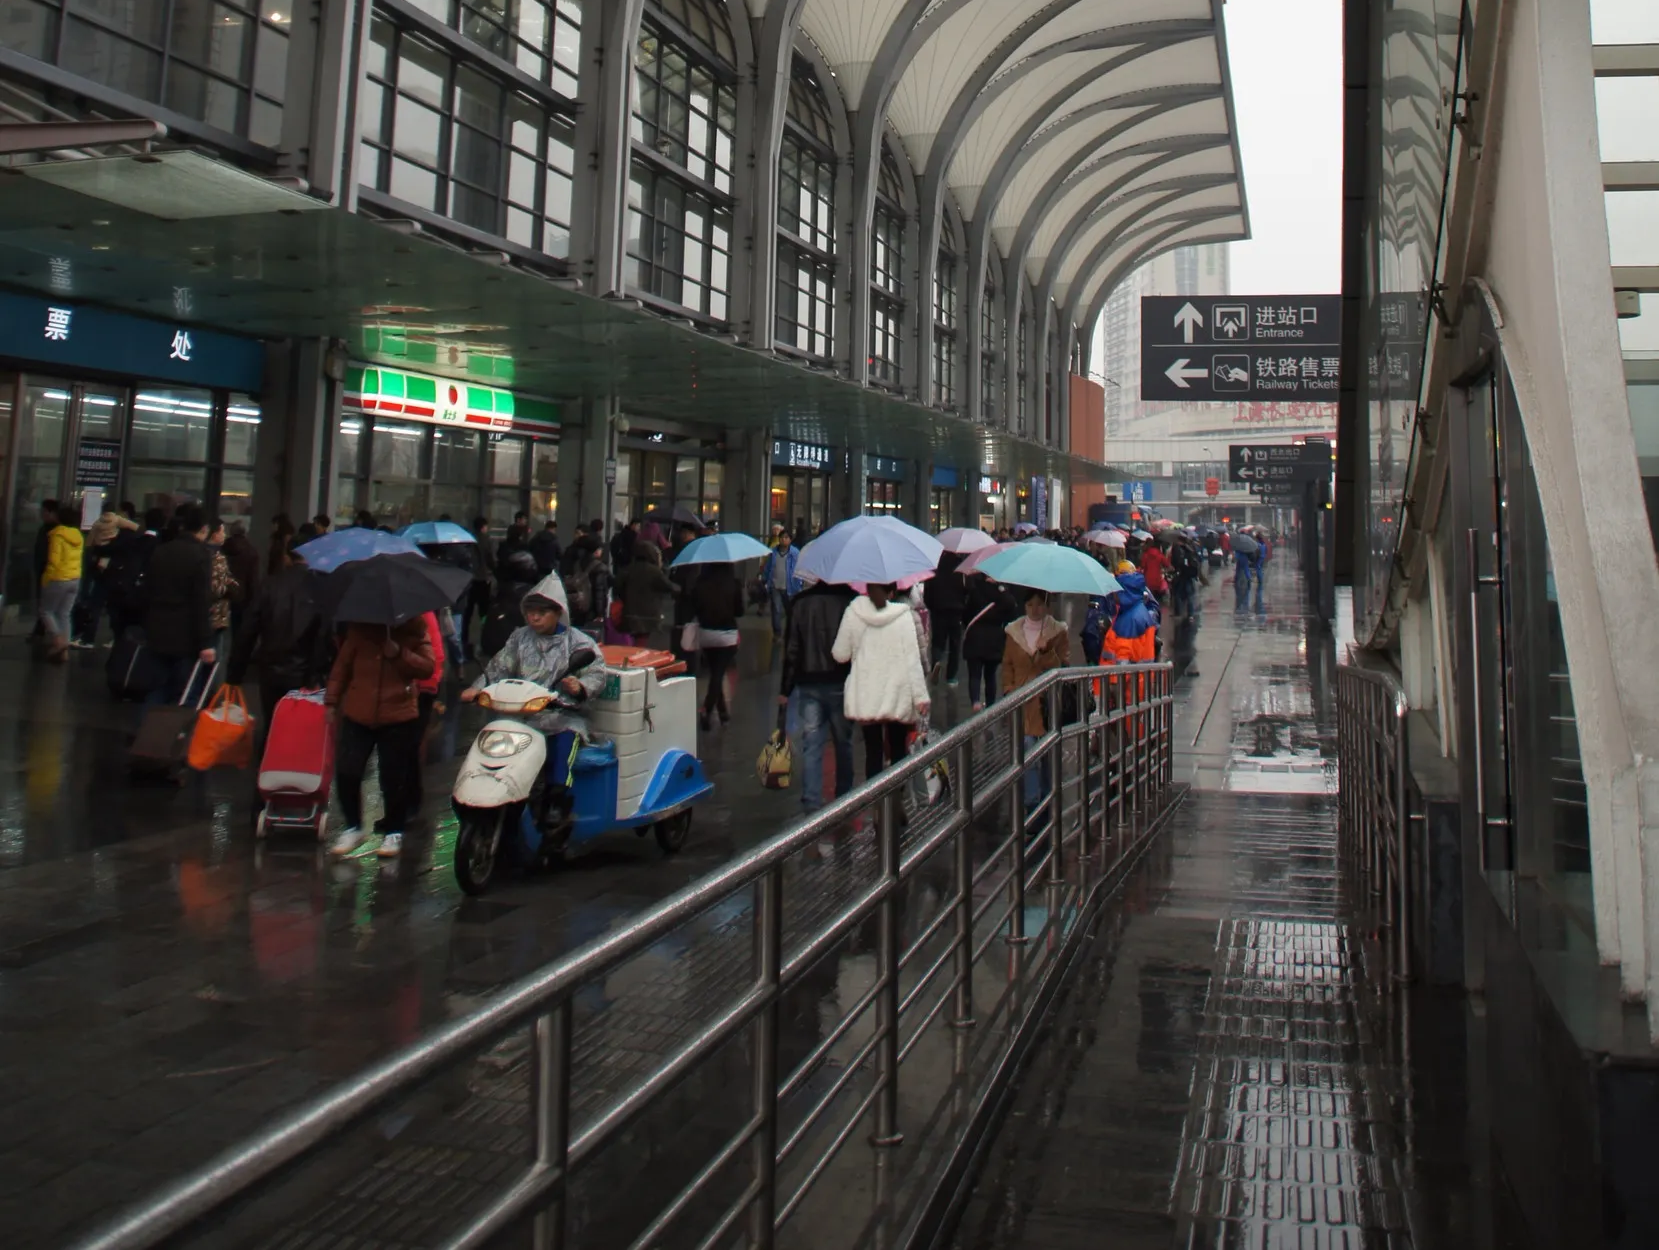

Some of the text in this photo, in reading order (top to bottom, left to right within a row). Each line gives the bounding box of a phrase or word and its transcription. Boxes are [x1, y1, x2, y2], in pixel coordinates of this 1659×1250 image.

[1255, 306, 1318, 326] 进站口
[1255, 327, 1304, 338] Entrance
[1255, 356, 1340, 378] 铁路售票
[1256, 379, 1340, 391] Railway Tickets
